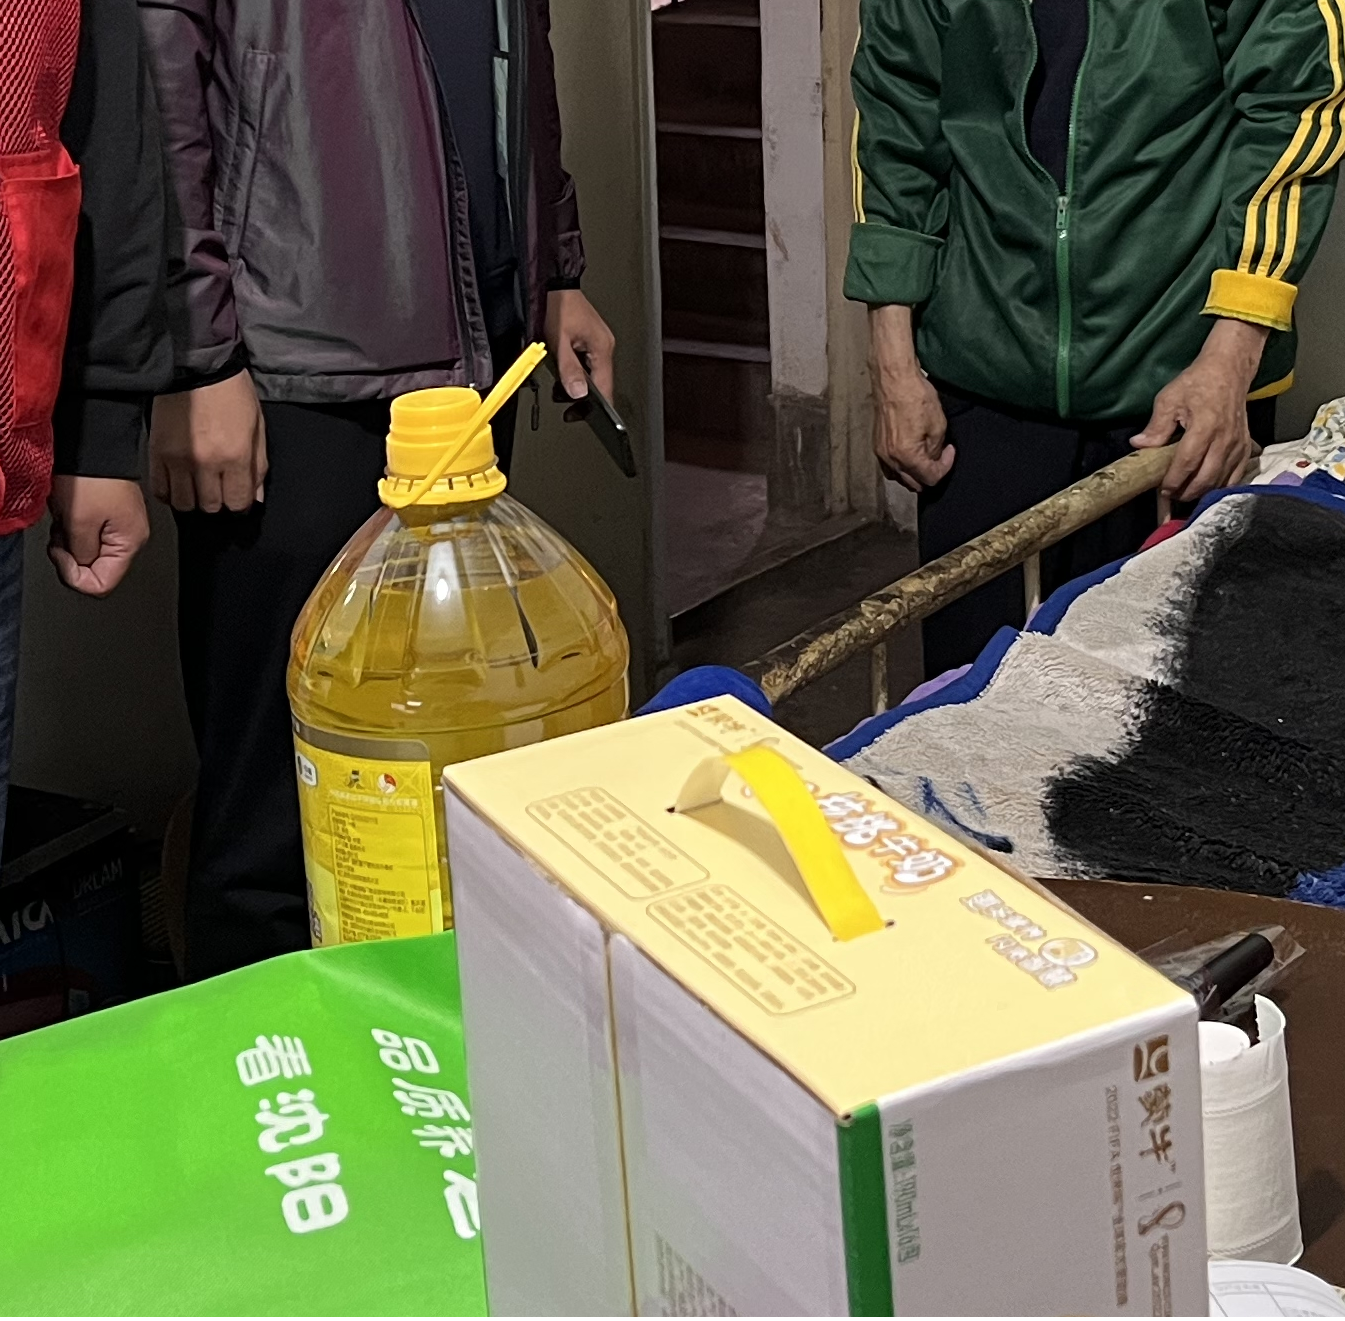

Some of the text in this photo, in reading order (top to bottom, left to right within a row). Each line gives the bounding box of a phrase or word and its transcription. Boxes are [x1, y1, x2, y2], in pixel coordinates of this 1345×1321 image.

[235, 1034, 350, 1234] 看沈阳
[1137, 1082, 1174, 1165] 蒙牛
